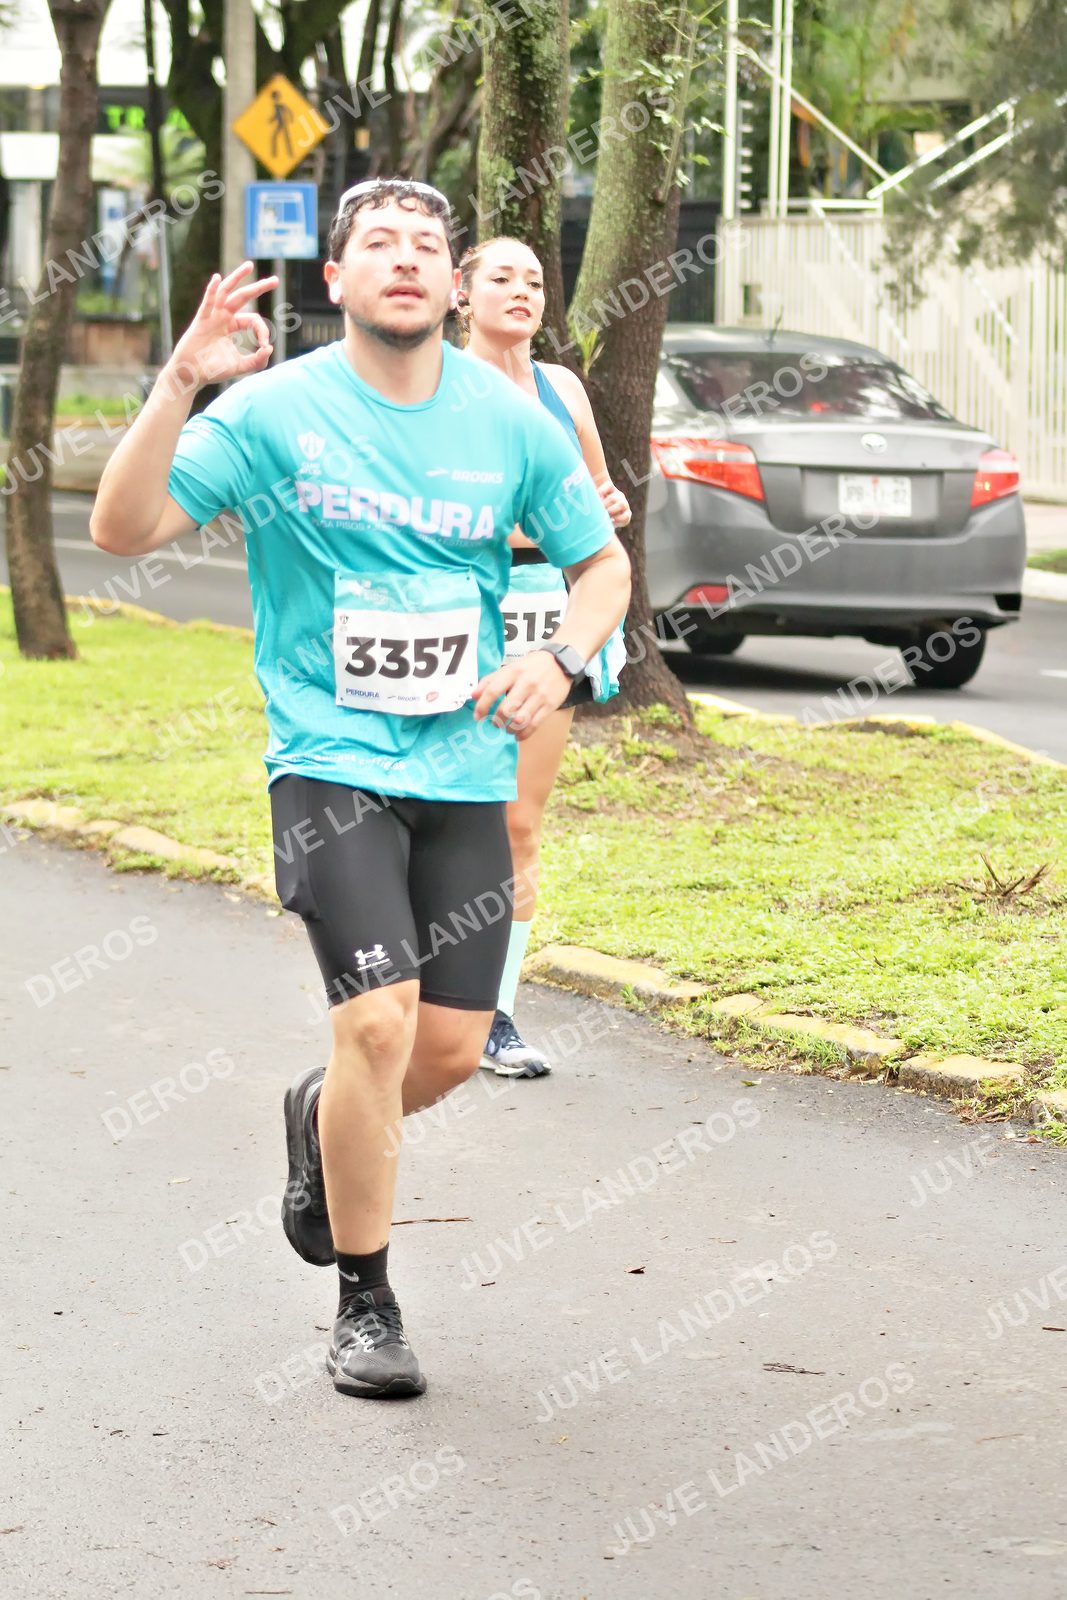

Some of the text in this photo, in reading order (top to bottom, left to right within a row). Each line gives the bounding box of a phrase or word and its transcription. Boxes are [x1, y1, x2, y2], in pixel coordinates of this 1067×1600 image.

[451, 469, 504, 484] BROOKS
[295, 480, 495, 540] PERDURA
[345, 633, 469, 679] 3357
[346, 688, 379, 699] PERDURA
